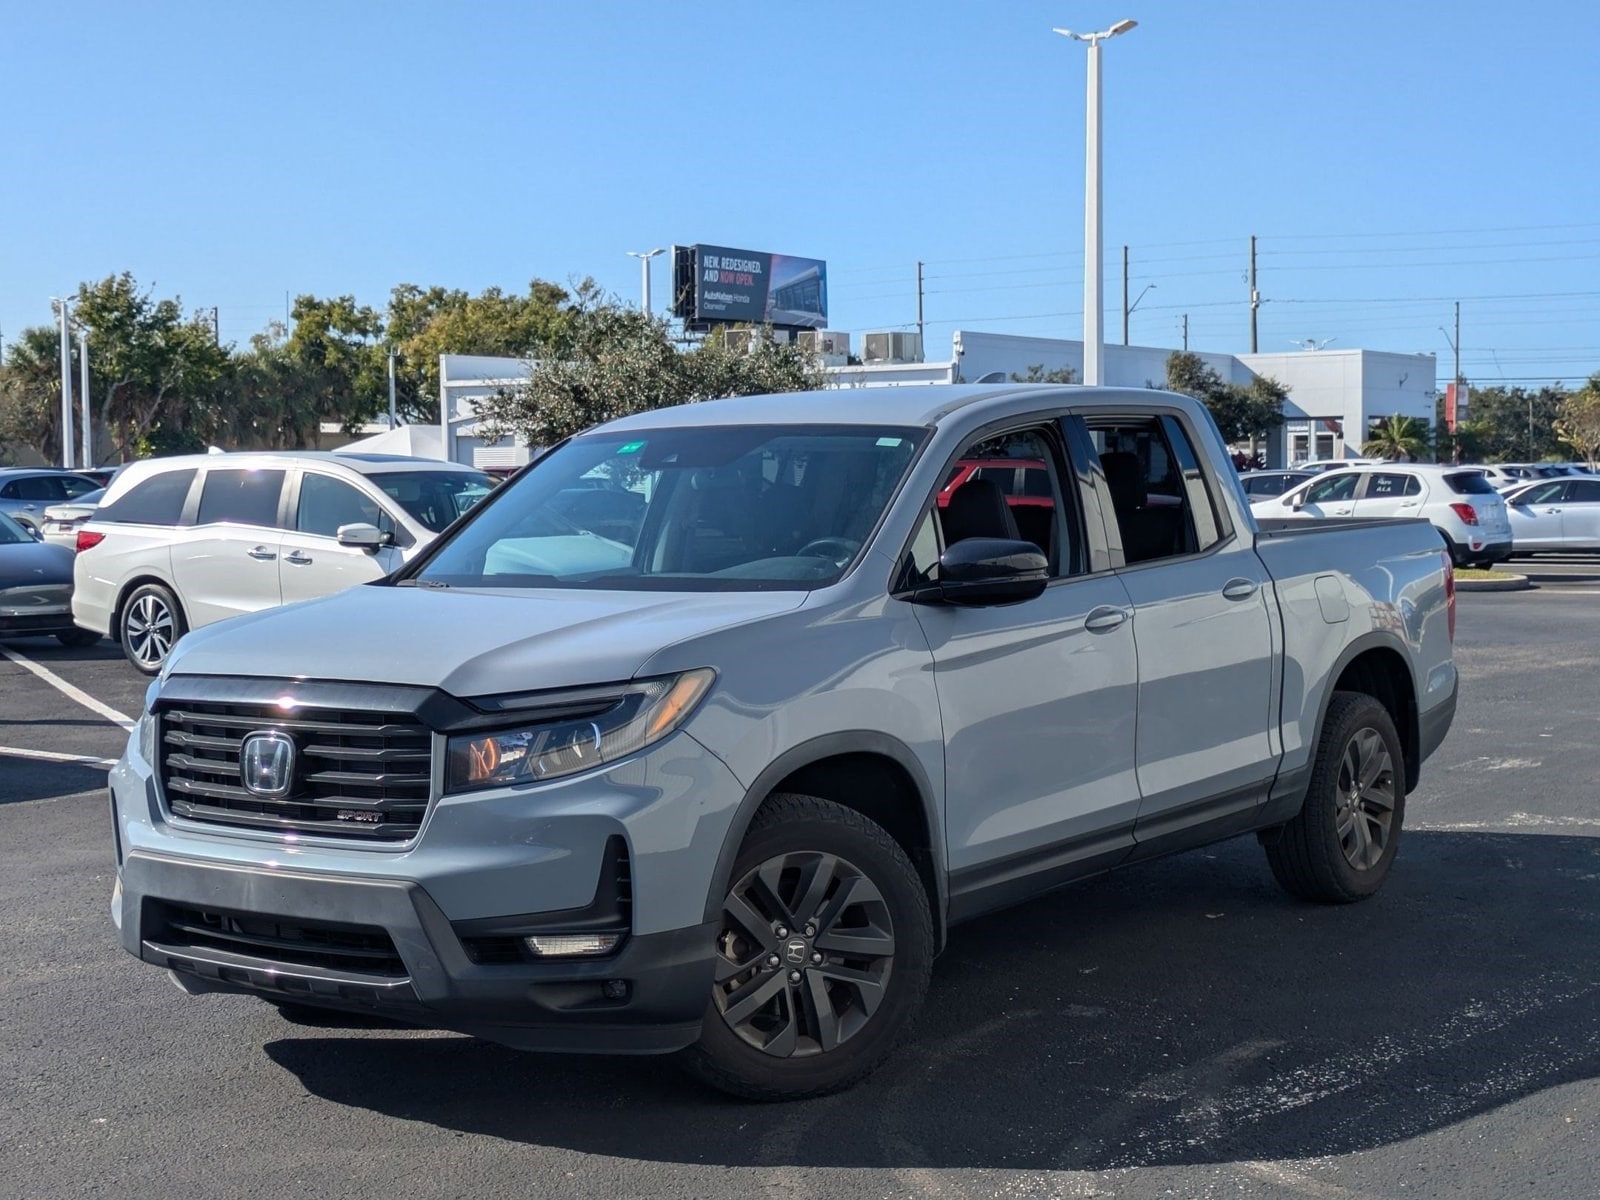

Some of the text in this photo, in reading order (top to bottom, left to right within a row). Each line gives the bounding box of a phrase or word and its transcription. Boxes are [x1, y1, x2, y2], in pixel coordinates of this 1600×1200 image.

[704, 256, 762, 274] NEW. REDESIGNED.
[704, 269, 754, 286] AND NOW OPEN.
[733, 294, 750, 303] Honda
[337, 810, 383, 822] SPORT
